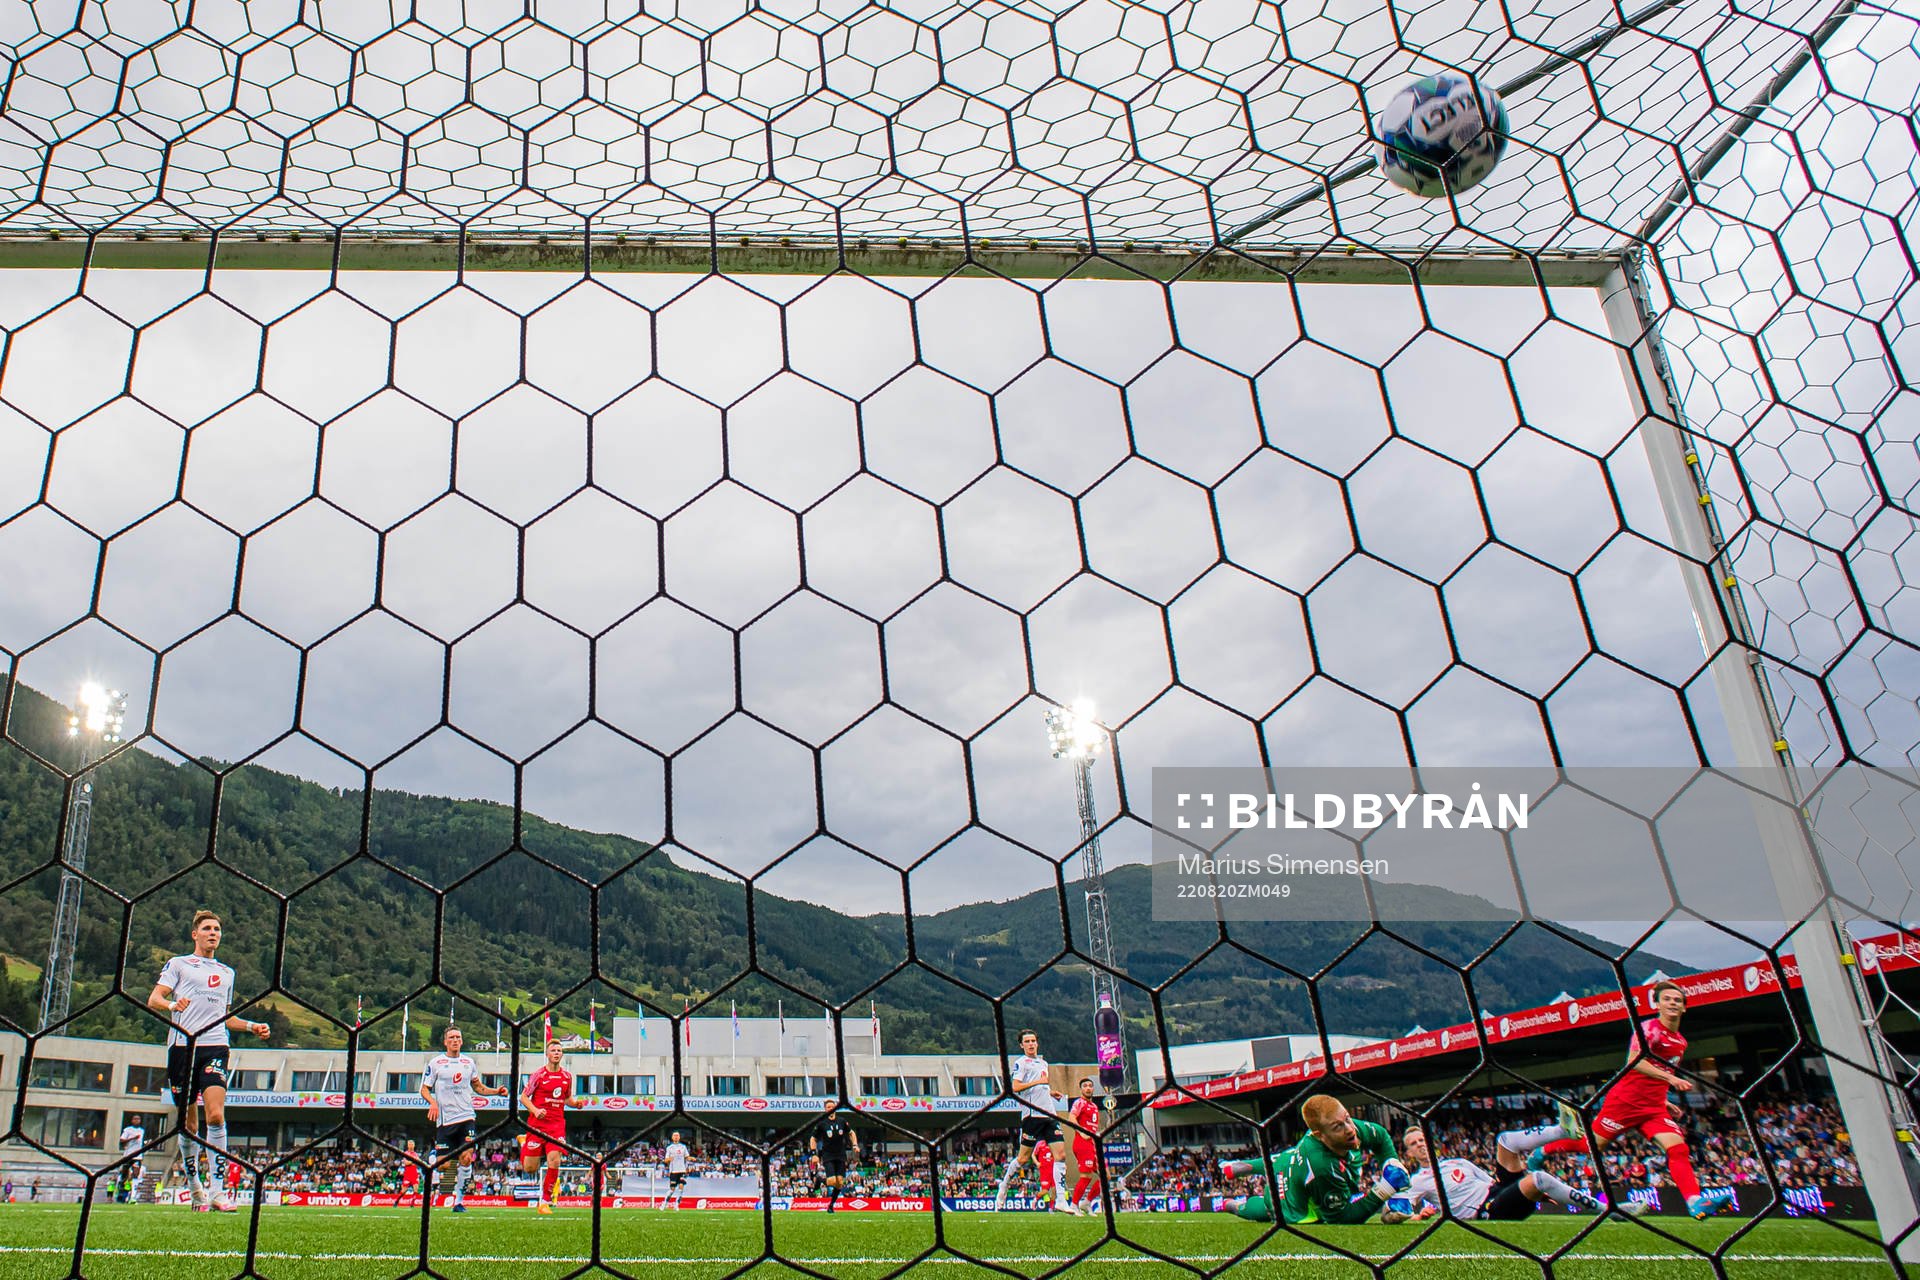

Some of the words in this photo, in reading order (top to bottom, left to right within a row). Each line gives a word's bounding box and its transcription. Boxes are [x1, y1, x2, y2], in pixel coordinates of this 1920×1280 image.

[211, 1059, 222, 1067] 26
[225, 1095, 264, 1104] FTBYGDA
[271, 1095, 294, 1104] SOGN
[658, 1099, 710, 1108] SAFYGDA
[717, 1099, 740, 1108] SOGN
[770, 1100, 820, 1109] SAFTBYGDA
[307, 1195, 350, 1206] umbro
[881, 1199, 923, 1211] umbro
